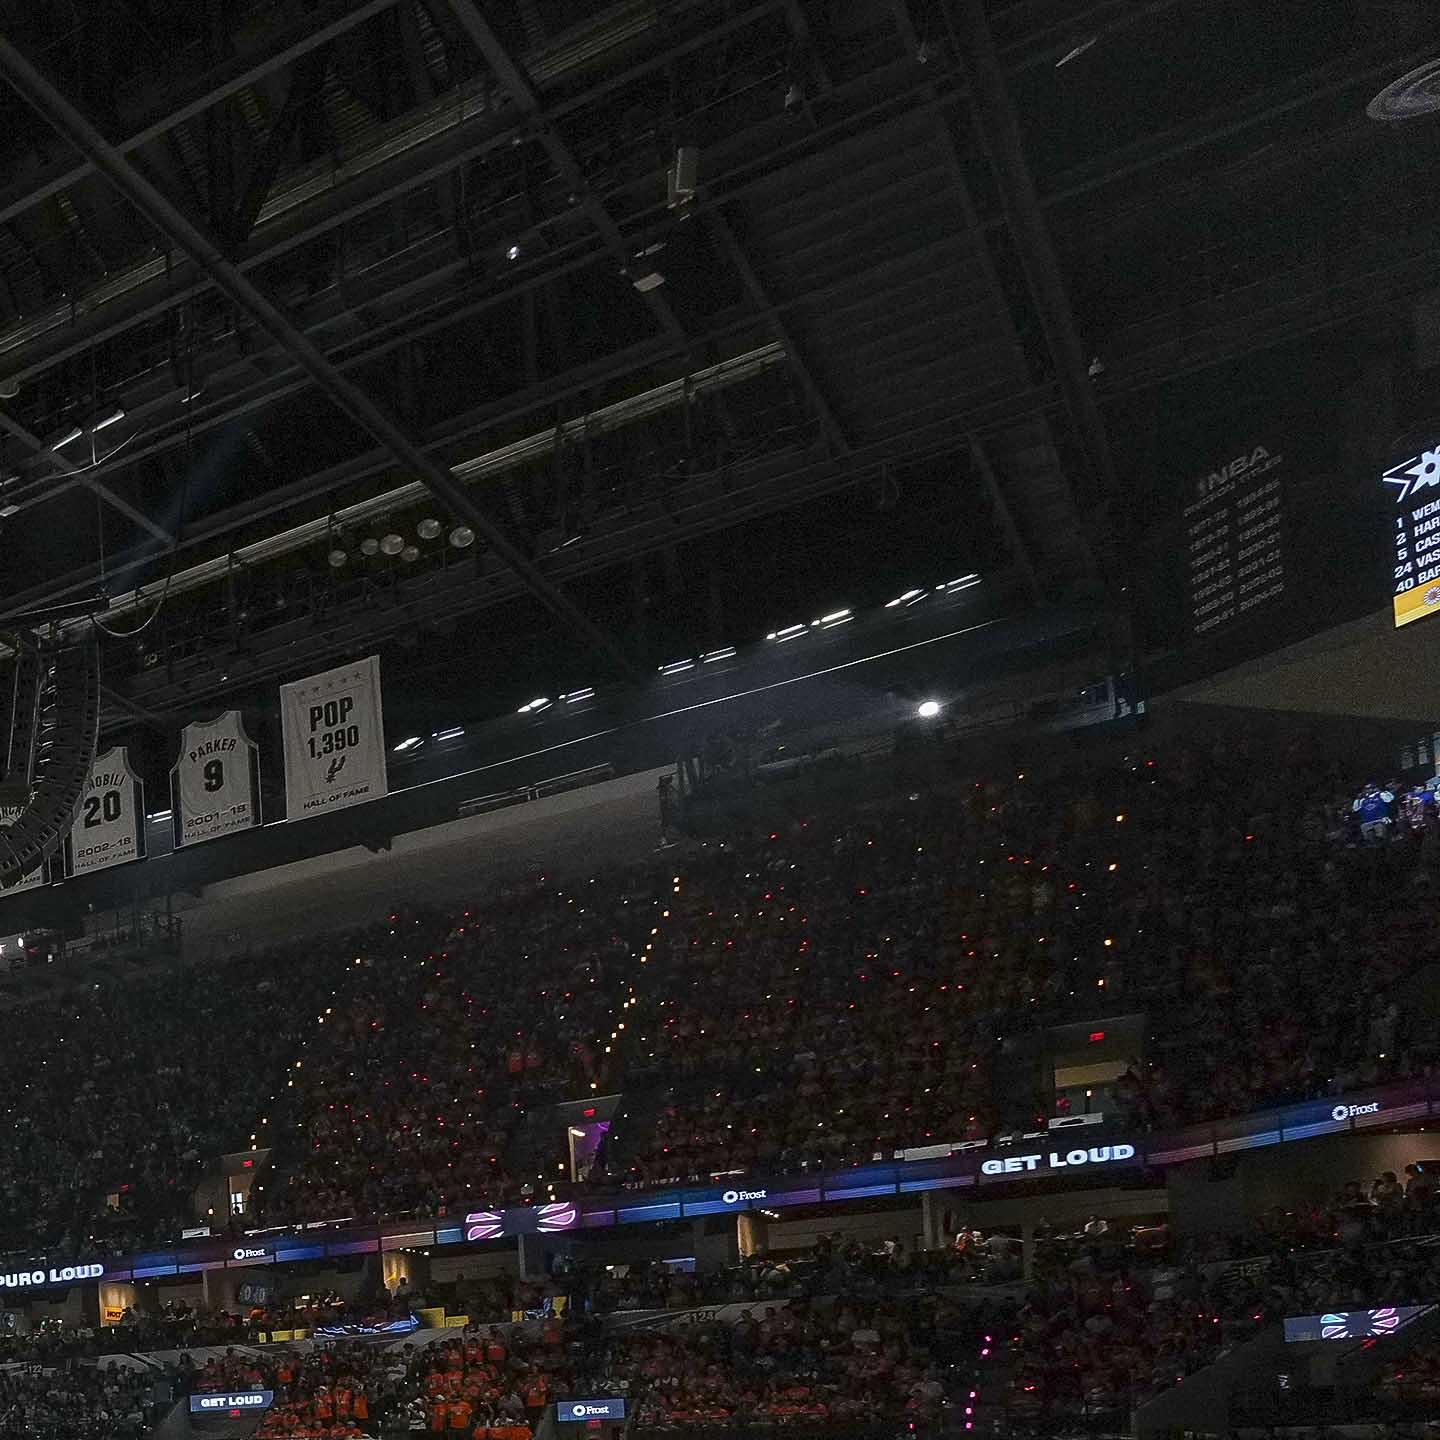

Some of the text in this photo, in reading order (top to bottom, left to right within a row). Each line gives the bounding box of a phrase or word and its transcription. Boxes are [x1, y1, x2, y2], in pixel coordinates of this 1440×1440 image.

[310, 697, 353, 732] POP
[189, 737, 237, 763] PARKER
[307, 725, 359, 760] 1,390
[203, 759, 224, 792] 9
[83, 790, 122, 829] 20
[303, 796, 326, 810] HALL
[343, 786, 370, 799] FAME
[1348, 1102, 1380, 1117] Frost
[981, 1143, 1135, 1176] GET LOUD
[739, 1189, 767, 1200] Frost
[245, 1249, 265, 1257] Frost
[49, 1263, 104, 1283] LOUD
[200, 1395, 263, 1408] GET LOUD
[585, 1406, 609, 1415] Frost
